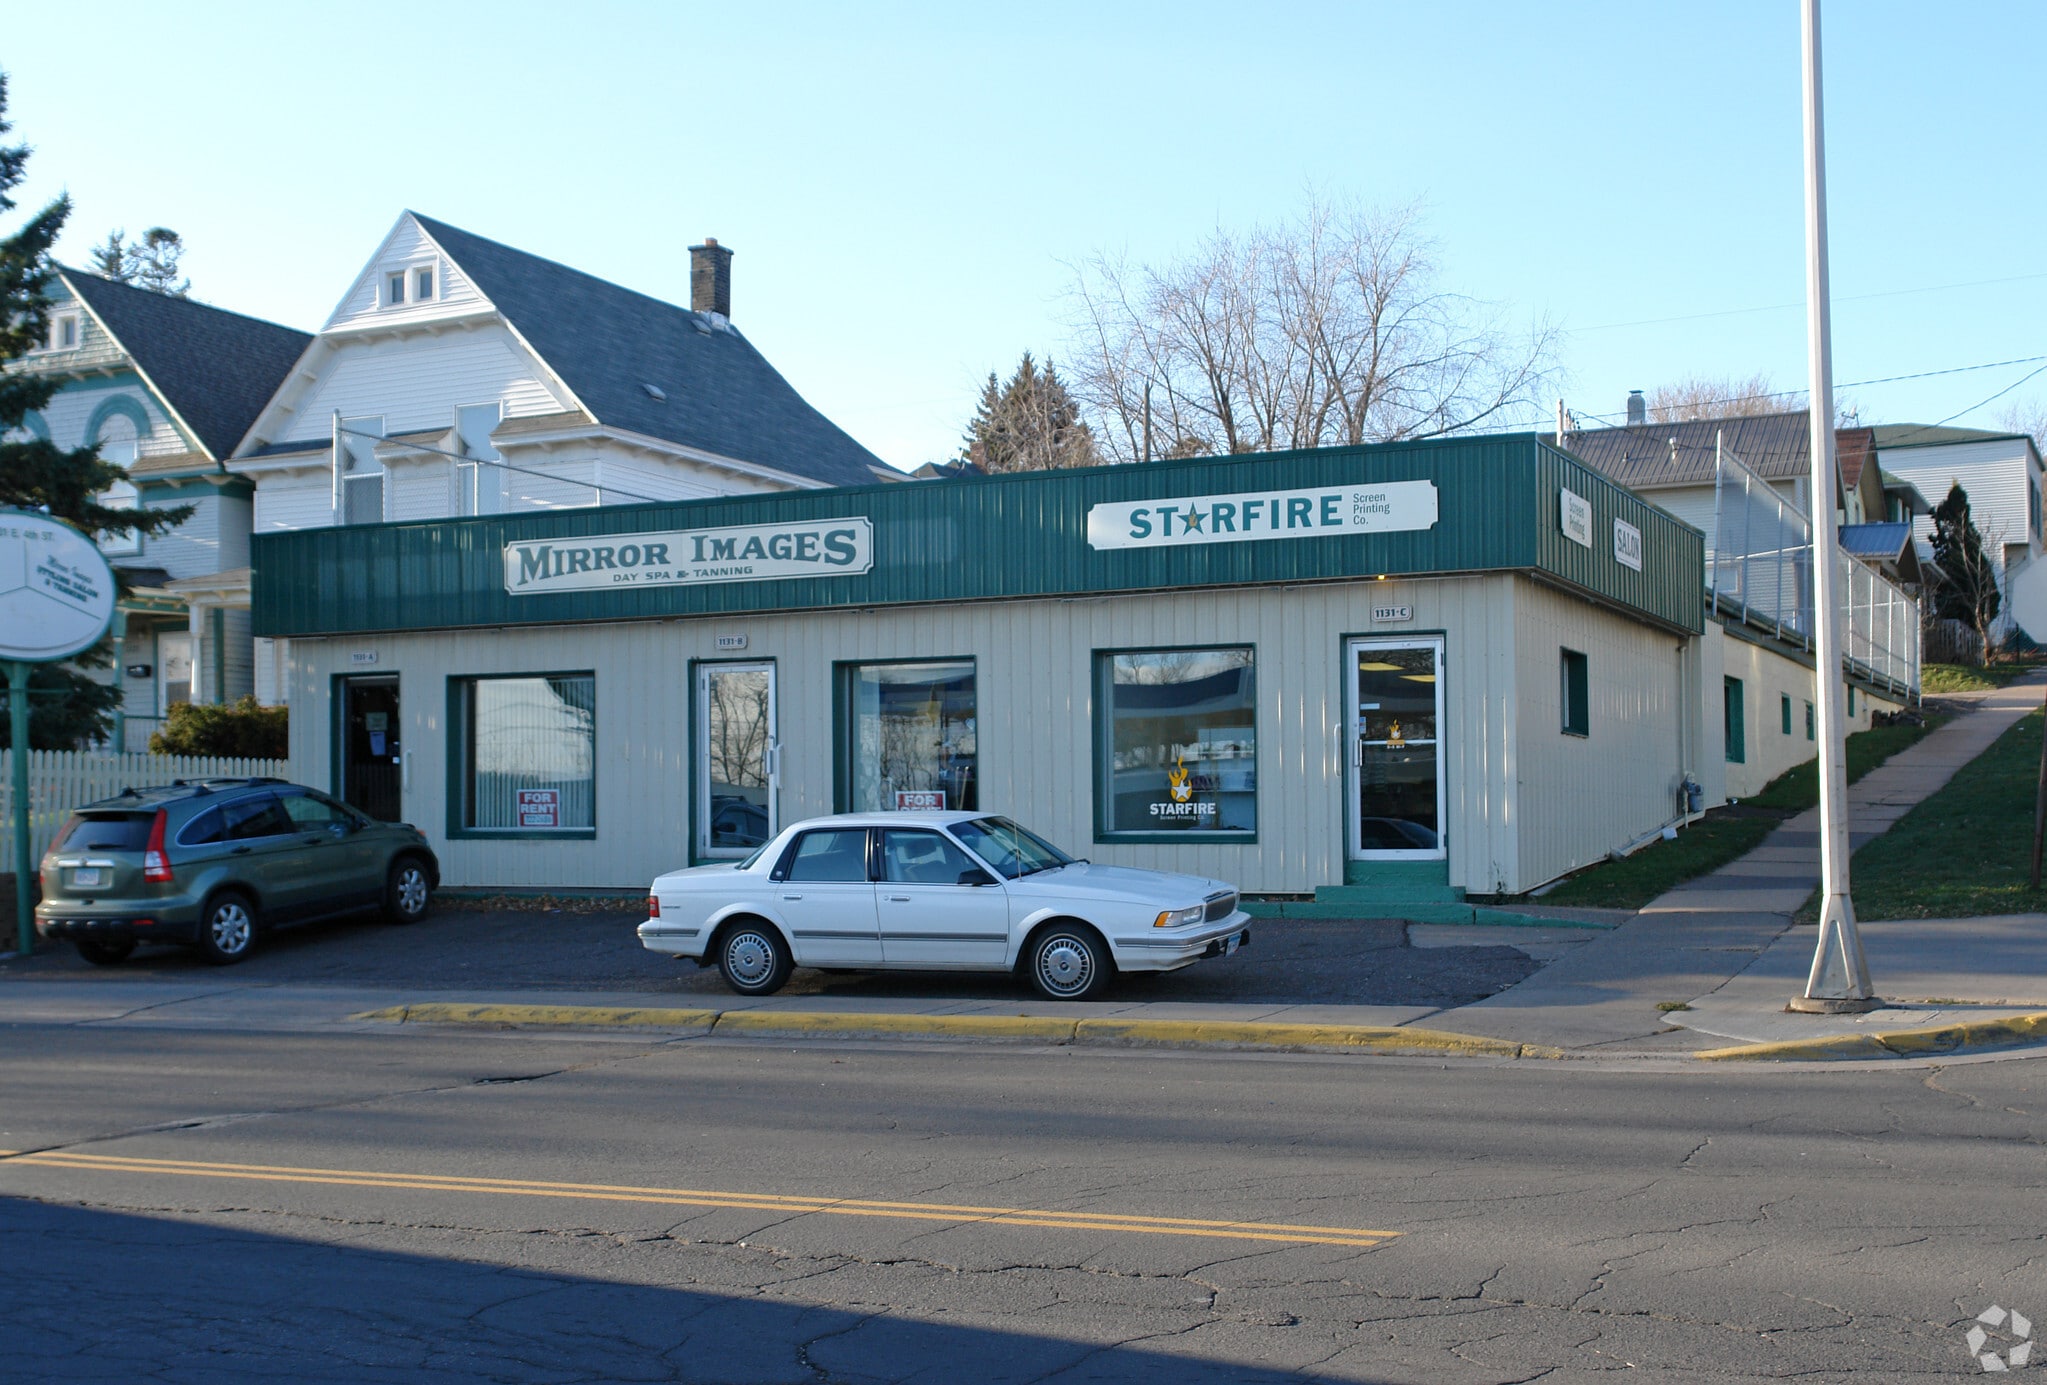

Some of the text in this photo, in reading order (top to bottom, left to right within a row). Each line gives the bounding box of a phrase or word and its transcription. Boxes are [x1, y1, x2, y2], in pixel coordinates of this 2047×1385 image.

[1353, 493, 1386, 503] Screen
[1353, 503, 1390, 515] Printing
[1353, 514, 1369, 525] Co.
[1617, 528, 1640, 561] SALON
[516, 529, 857, 586] MIRROR IMAGES
[613, 566, 753, 582] DAY SPA & TANNING
[524, 792, 551, 803] FOR
[904, 795, 935, 805] FOR
[521, 804, 555, 813] RENT
[1150, 803, 1216, 815] STARFIRE
